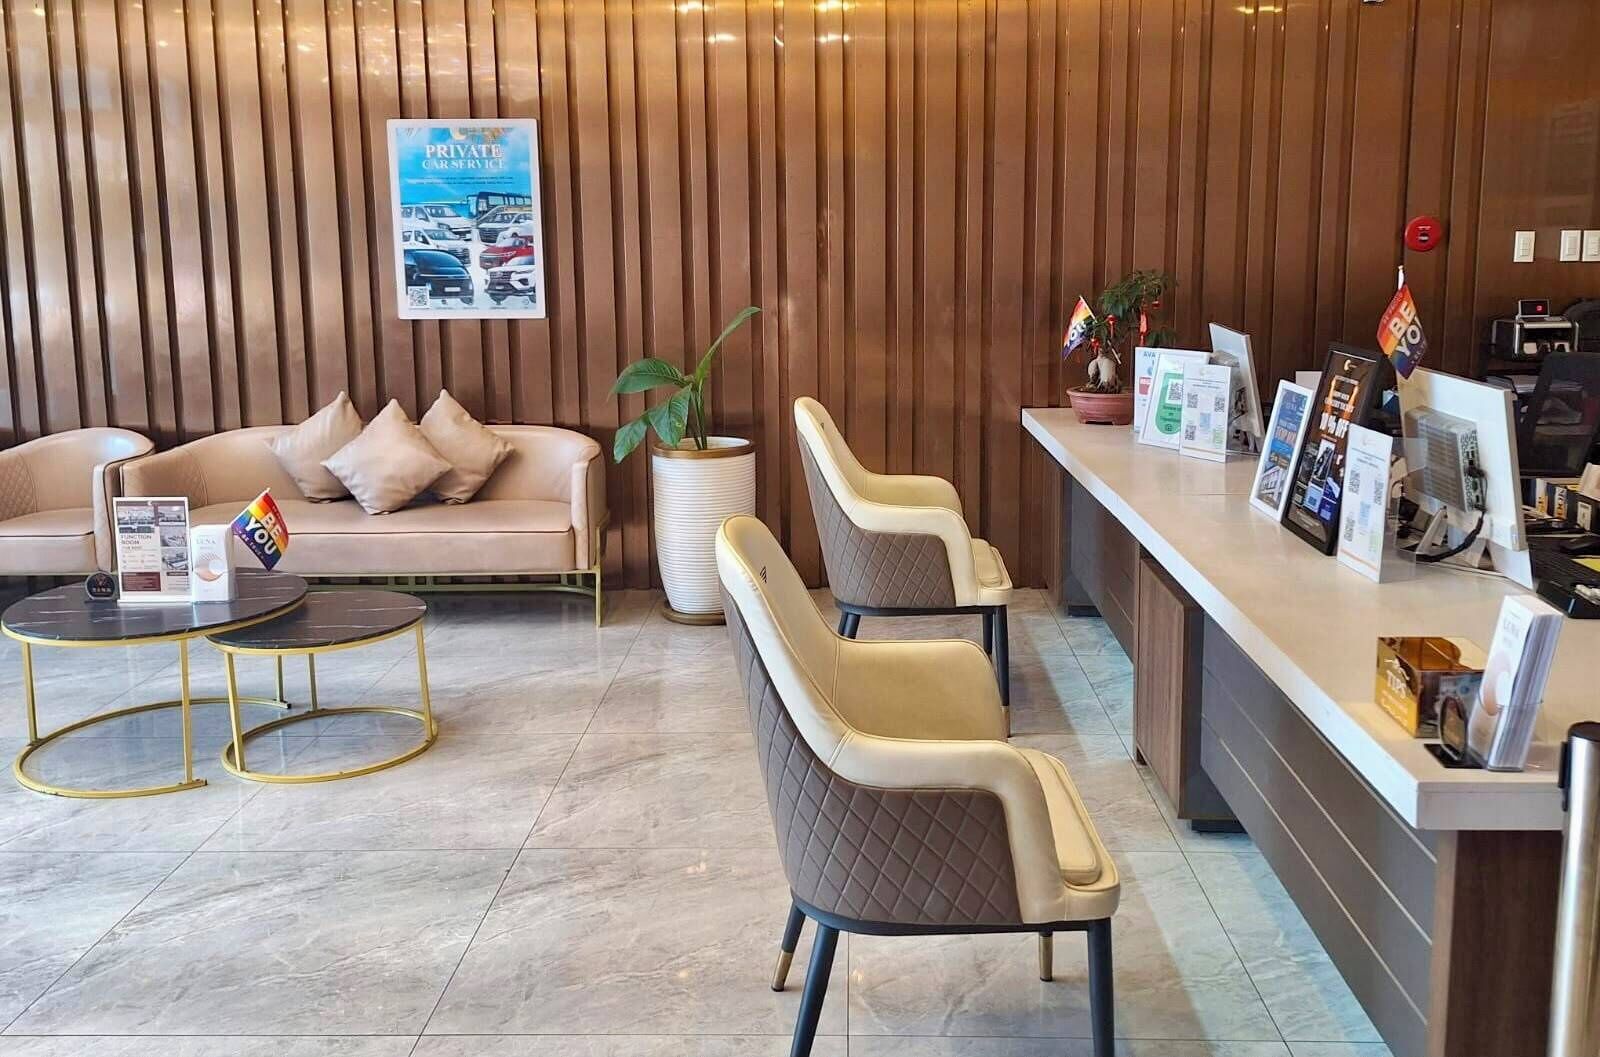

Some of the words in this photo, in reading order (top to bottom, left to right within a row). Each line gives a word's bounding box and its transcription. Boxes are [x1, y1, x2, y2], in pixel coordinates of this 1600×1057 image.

[425, 143, 502, 159] PRIVATE
[421, 159, 449, 170] CAR
[450, 159, 505, 169] SERVICE
[260, 511, 282, 538] BE
[245, 516, 277, 555] YOU
